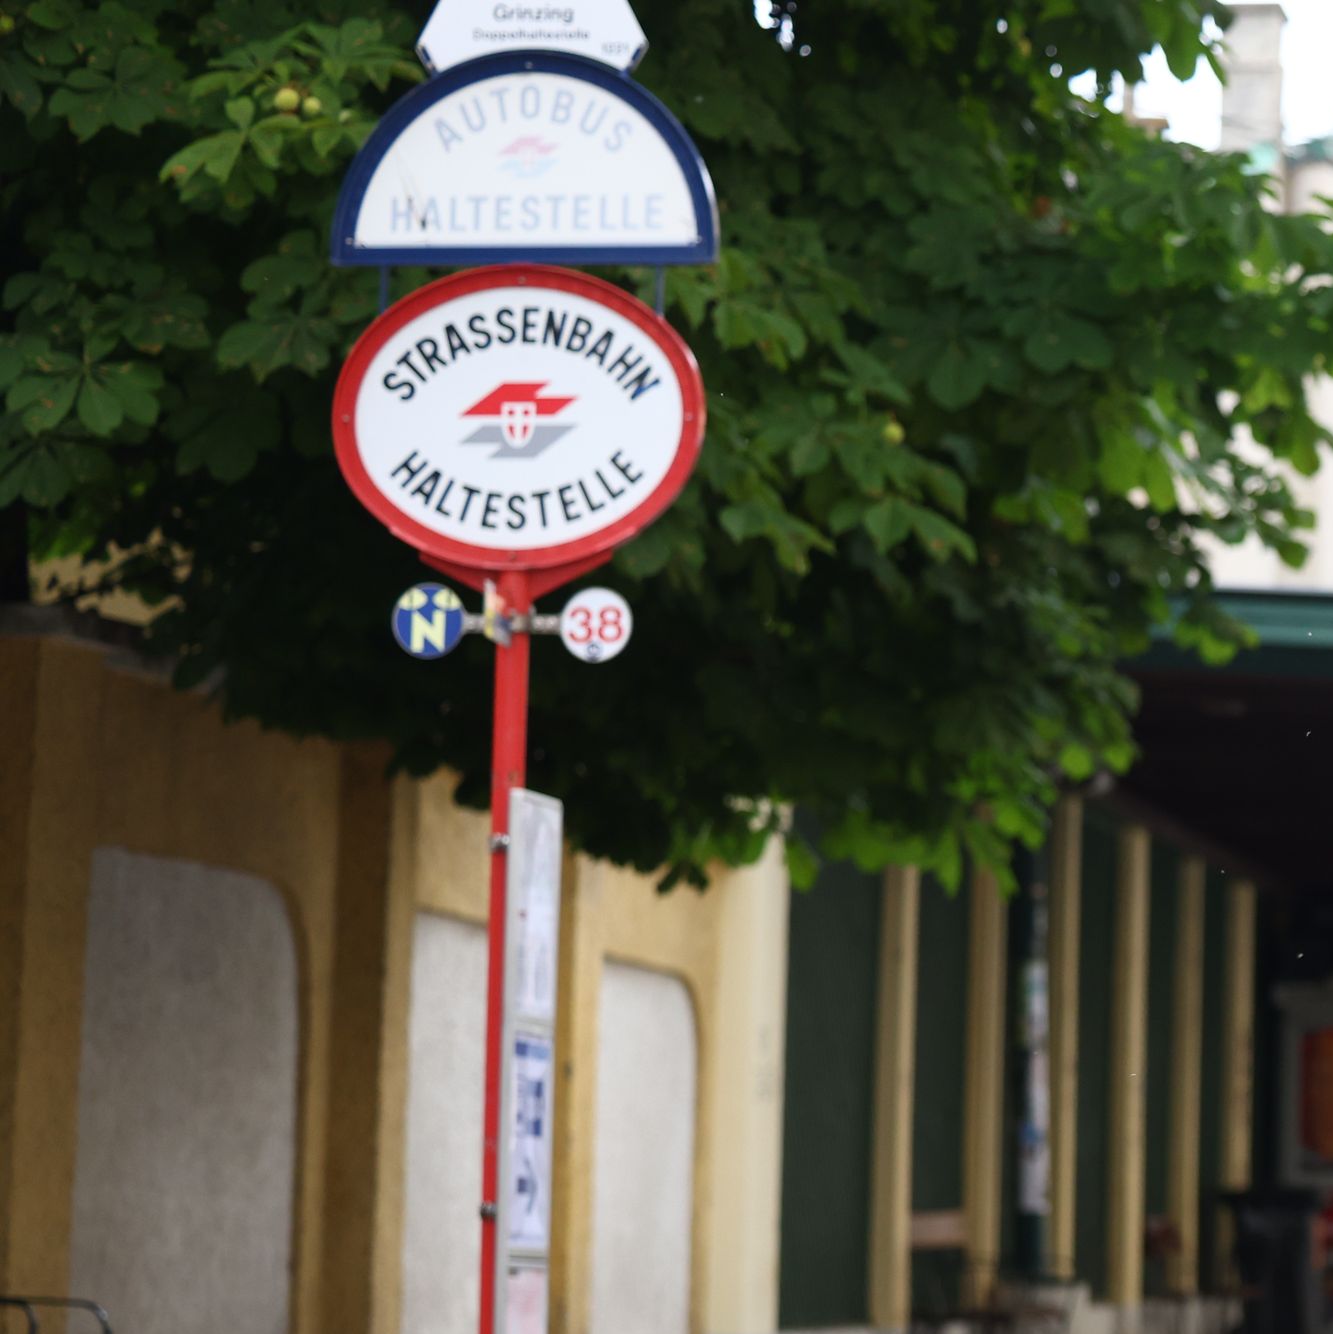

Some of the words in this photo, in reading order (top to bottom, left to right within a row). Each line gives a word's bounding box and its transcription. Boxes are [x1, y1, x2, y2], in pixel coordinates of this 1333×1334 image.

[493, 3, 575, 24] Grinzing
[433, 83, 633, 154] AUTOBUS
[389, 194, 664, 232] HALTESTELLE
[383, 307, 661, 403] STRASSENBAHN
[390, 449, 644, 531] HALTESTELLE
[410, 611, 446, 653] N
[569, 606, 623, 644] 38
